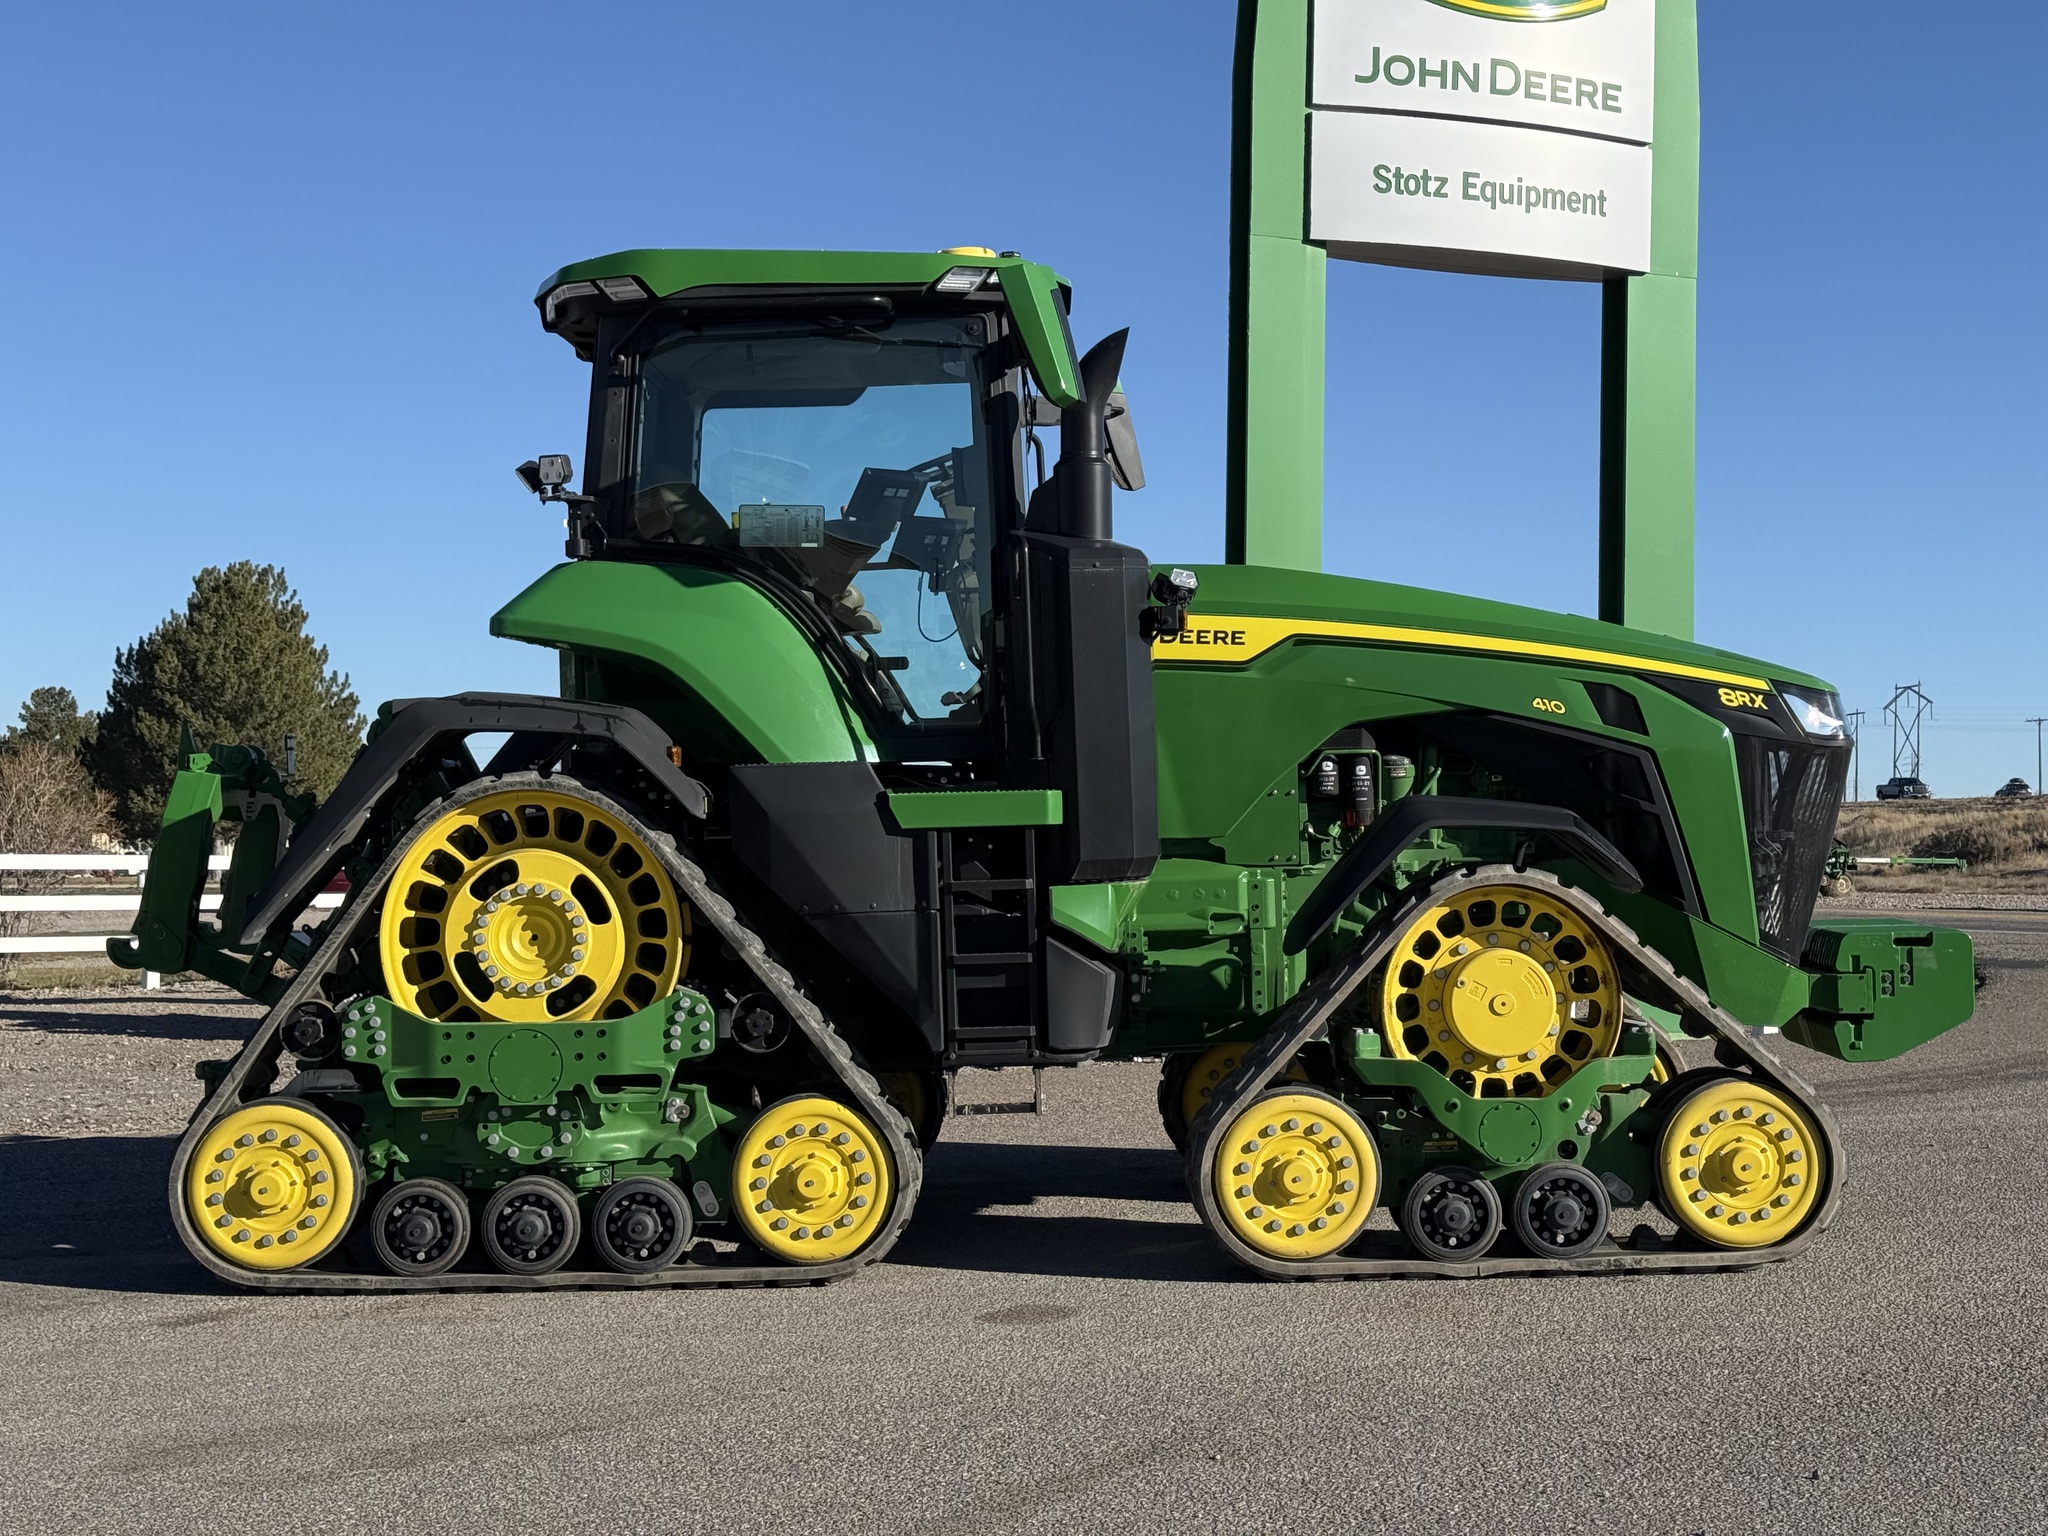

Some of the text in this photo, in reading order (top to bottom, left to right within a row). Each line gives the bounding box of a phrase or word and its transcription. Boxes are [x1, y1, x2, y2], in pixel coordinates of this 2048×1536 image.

[1354, 46, 1623, 114] JOHN DEERE
[1372, 163, 1607, 218] Stotz Equipment
[1531, 697, 1566, 714] 410
[1717, 687, 1769, 710] 8RX
